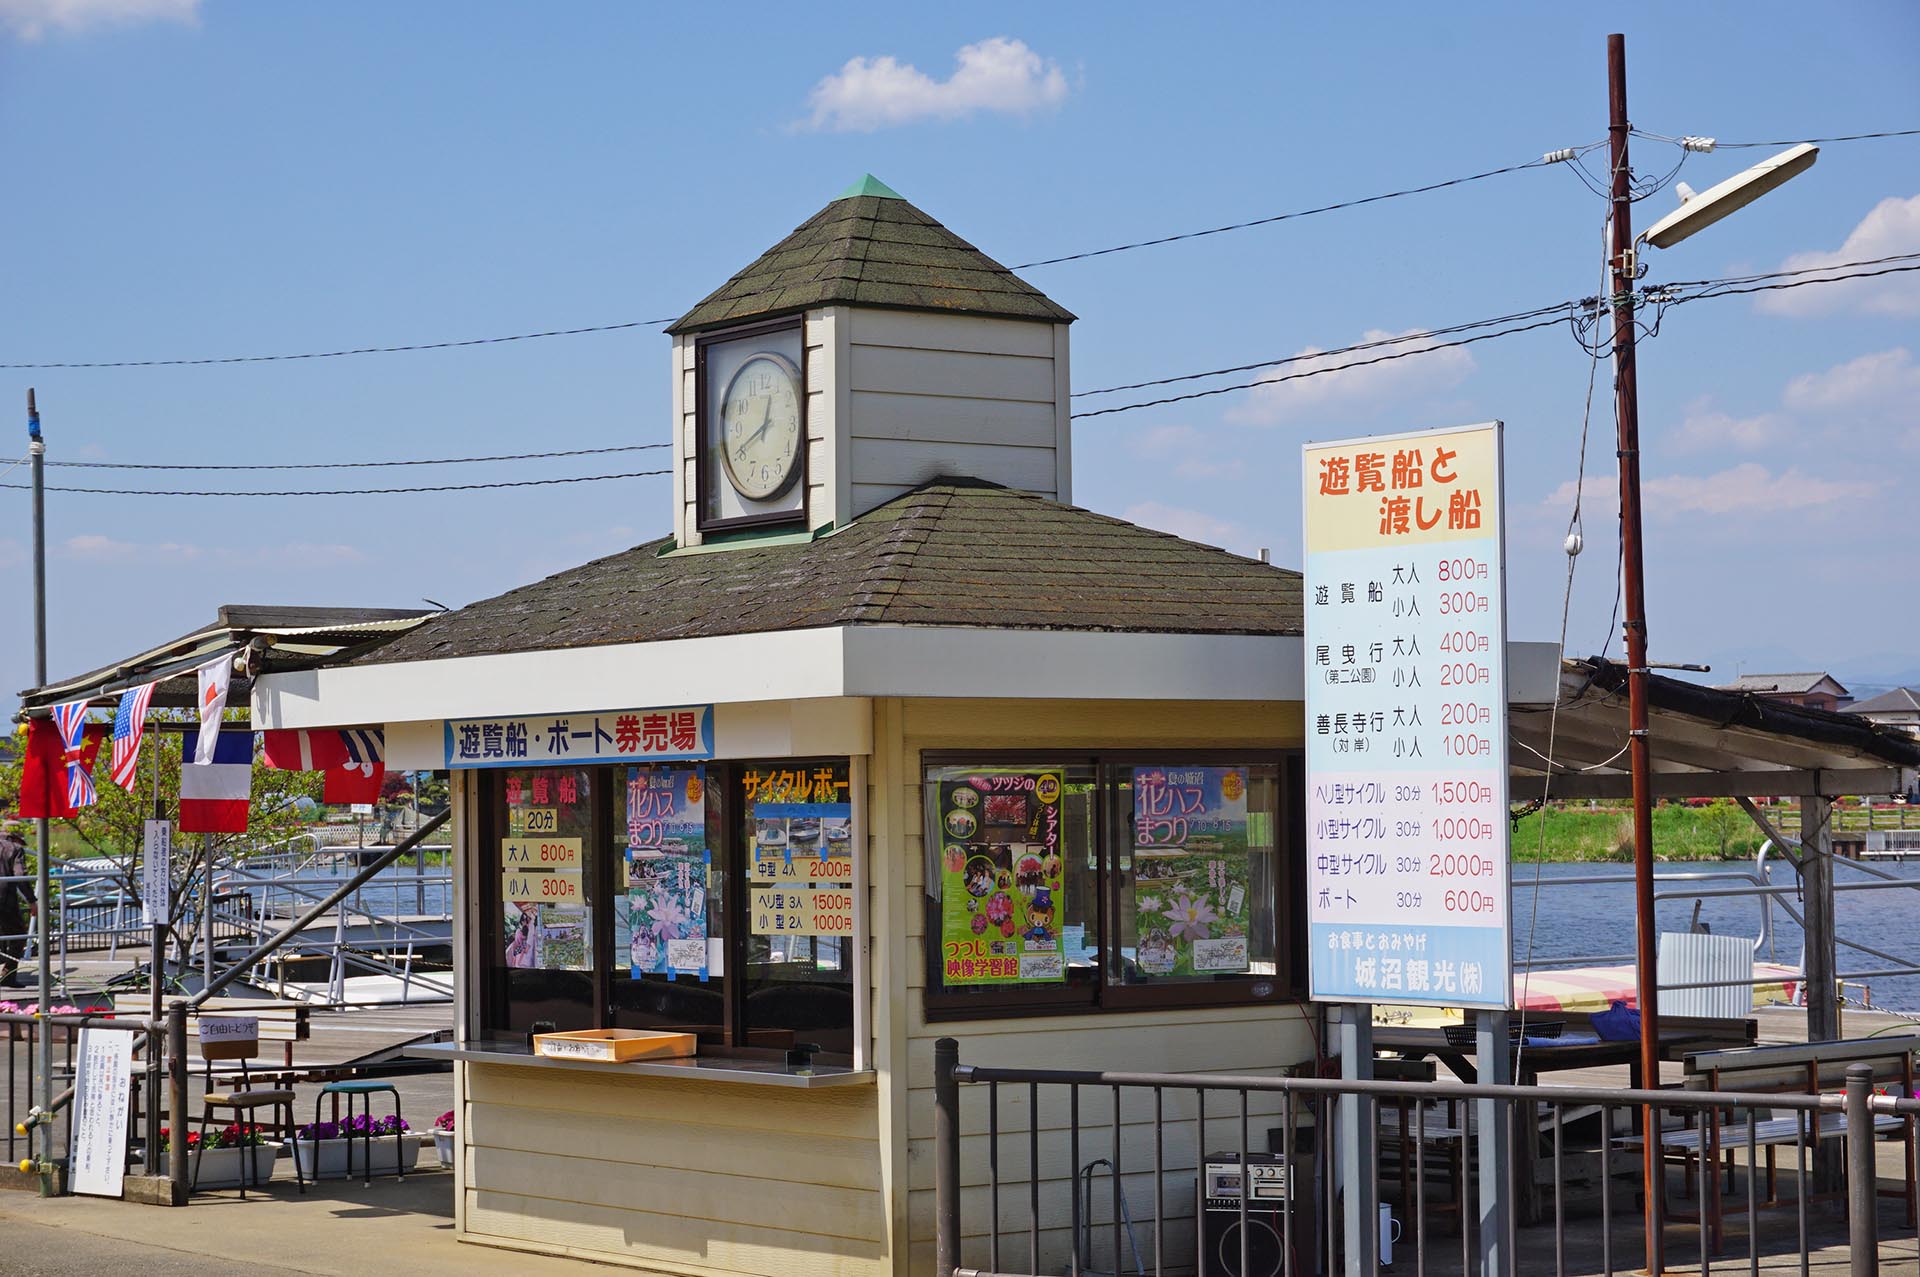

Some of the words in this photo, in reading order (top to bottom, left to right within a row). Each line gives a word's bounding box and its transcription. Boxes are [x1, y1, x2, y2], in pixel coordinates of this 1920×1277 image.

[749, 380, 757, 397] 11
[760, 373, 771, 390] 12
[737, 399, 748, 416] 10
[735, 421, 742, 439] 9
[789, 415, 796, 433] 3
[784, 440, 791, 457] 4
[761, 464, 769, 482] 6
[1319, 447, 1458, 496] 遊覧船と
[1379, 489, 1481, 535] 渡し船
[1392, 562, 1420, 585] 大人
[1438, 558, 1488, 581] 800円
[1315, 580, 1383, 606] 遊覧船
[1392, 595, 1421, 617] 小人
[1439, 591, 1489, 615] 300円
[1315, 642, 1383, 666] 尾曳行
[1392, 634, 1421, 657] 大人
[1440, 631, 1489, 653] 400円
[1392, 666, 1421, 688] 小人
[1440, 663, 1489, 686] 200円
[1317, 712, 1384, 735] 善長寺行
[1393, 704, 1422, 727] 大人
[1441, 703, 1490, 725] 200円
[459, 712, 697, 759] 遊覧船・ボート券売場
[1332, 737, 1370, 753] (対岸)
[1393, 735, 1422, 758] 小人
[1443, 734, 1490, 756] 100円
[506, 776, 577, 804] 遊覧船
[992, 776, 1035, 791] ツツジの
[1038, 779, 1057, 794] 4D
[1136, 773, 1206, 816] 花ハス
[1316, 783, 1385, 805] ヘリ型サイクル
[1395, 785, 1421, 801] 30分
[1431, 781, 1492, 805] 1,500円
[629, 779, 675, 819] 花ハス
[528, 811, 554, 829] 20分
[1136, 817, 1188, 845] まつり
[1317, 818, 1387, 840] 小型サイクル
[1395, 821, 1421, 837] 30分
[1432, 818, 1493, 842] 1,000円
[628, 819, 664, 847] まつり
[1045, 805, 1058, 860] シアター
[509, 844, 529, 861] 大人
[541, 844, 574, 861] 800円
[759, 862, 776, 877] 中型
[810, 861, 851, 877] 2000円
[1317, 853, 1387, 876] 中型サイクル
[1396, 857, 1422, 873] 30分
[1429, 854, 1494, 877] 2,000円
[509, 879, 529, 895] 小人
[542, 879, 575, 896] 300円
[759, 894, 784, 909] ヘリ型
[789, 896, 802, 909] 3人
[812, 894, 851, 910] 1500円
[1318, 888, 1358, 910] ボート
[1396, 893, 1422, 908] 30分
[1444, 890, 1494, 913] 600円
[759, 914, 784, 929] 小型
[789, 916, 802, 929] 2人
[813, 914, 852, 930] 1000円
[945, 939, 986, 957] つつじ
[1328, 931, 1427, 952] お食事とおみやげ
[946, 958, 1018, 978] 映像学習館
[201, 1022, 257, 1035] ご自由にどうぞ
[115, 1077, 127, 1130] おねがい
